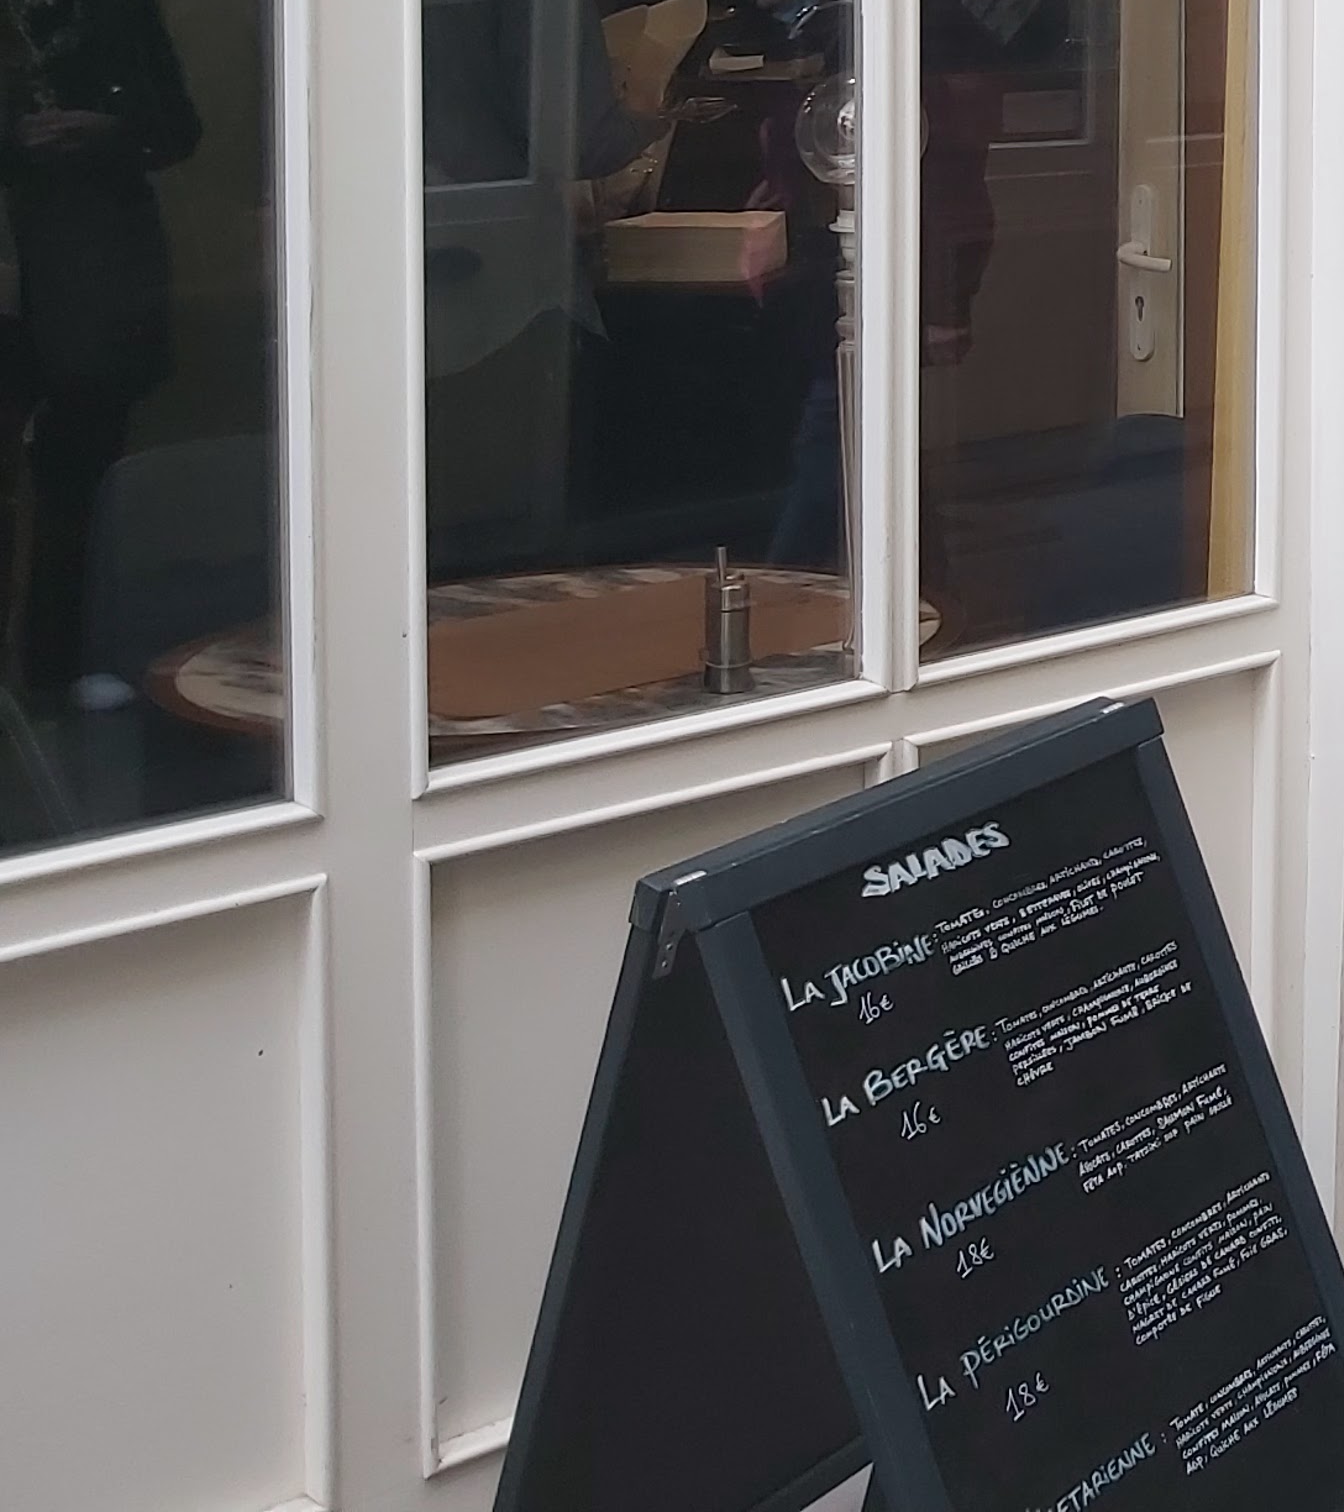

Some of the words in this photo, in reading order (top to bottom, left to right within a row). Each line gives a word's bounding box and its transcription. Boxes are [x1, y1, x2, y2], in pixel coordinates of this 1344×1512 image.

[862, 821, 1010, 898] SALADES
[782, 978, 825, 1013] LA
[858, 991, 896, 1025] 16€
[821, 1095, 861, 1127] LA
[872, 1237, 913, 1273] LA
[956, 1237, 995, 1278] 18€
[916, 1373, 956, 1412] LA
[1005, 1371, 1050, 1423] 18€
